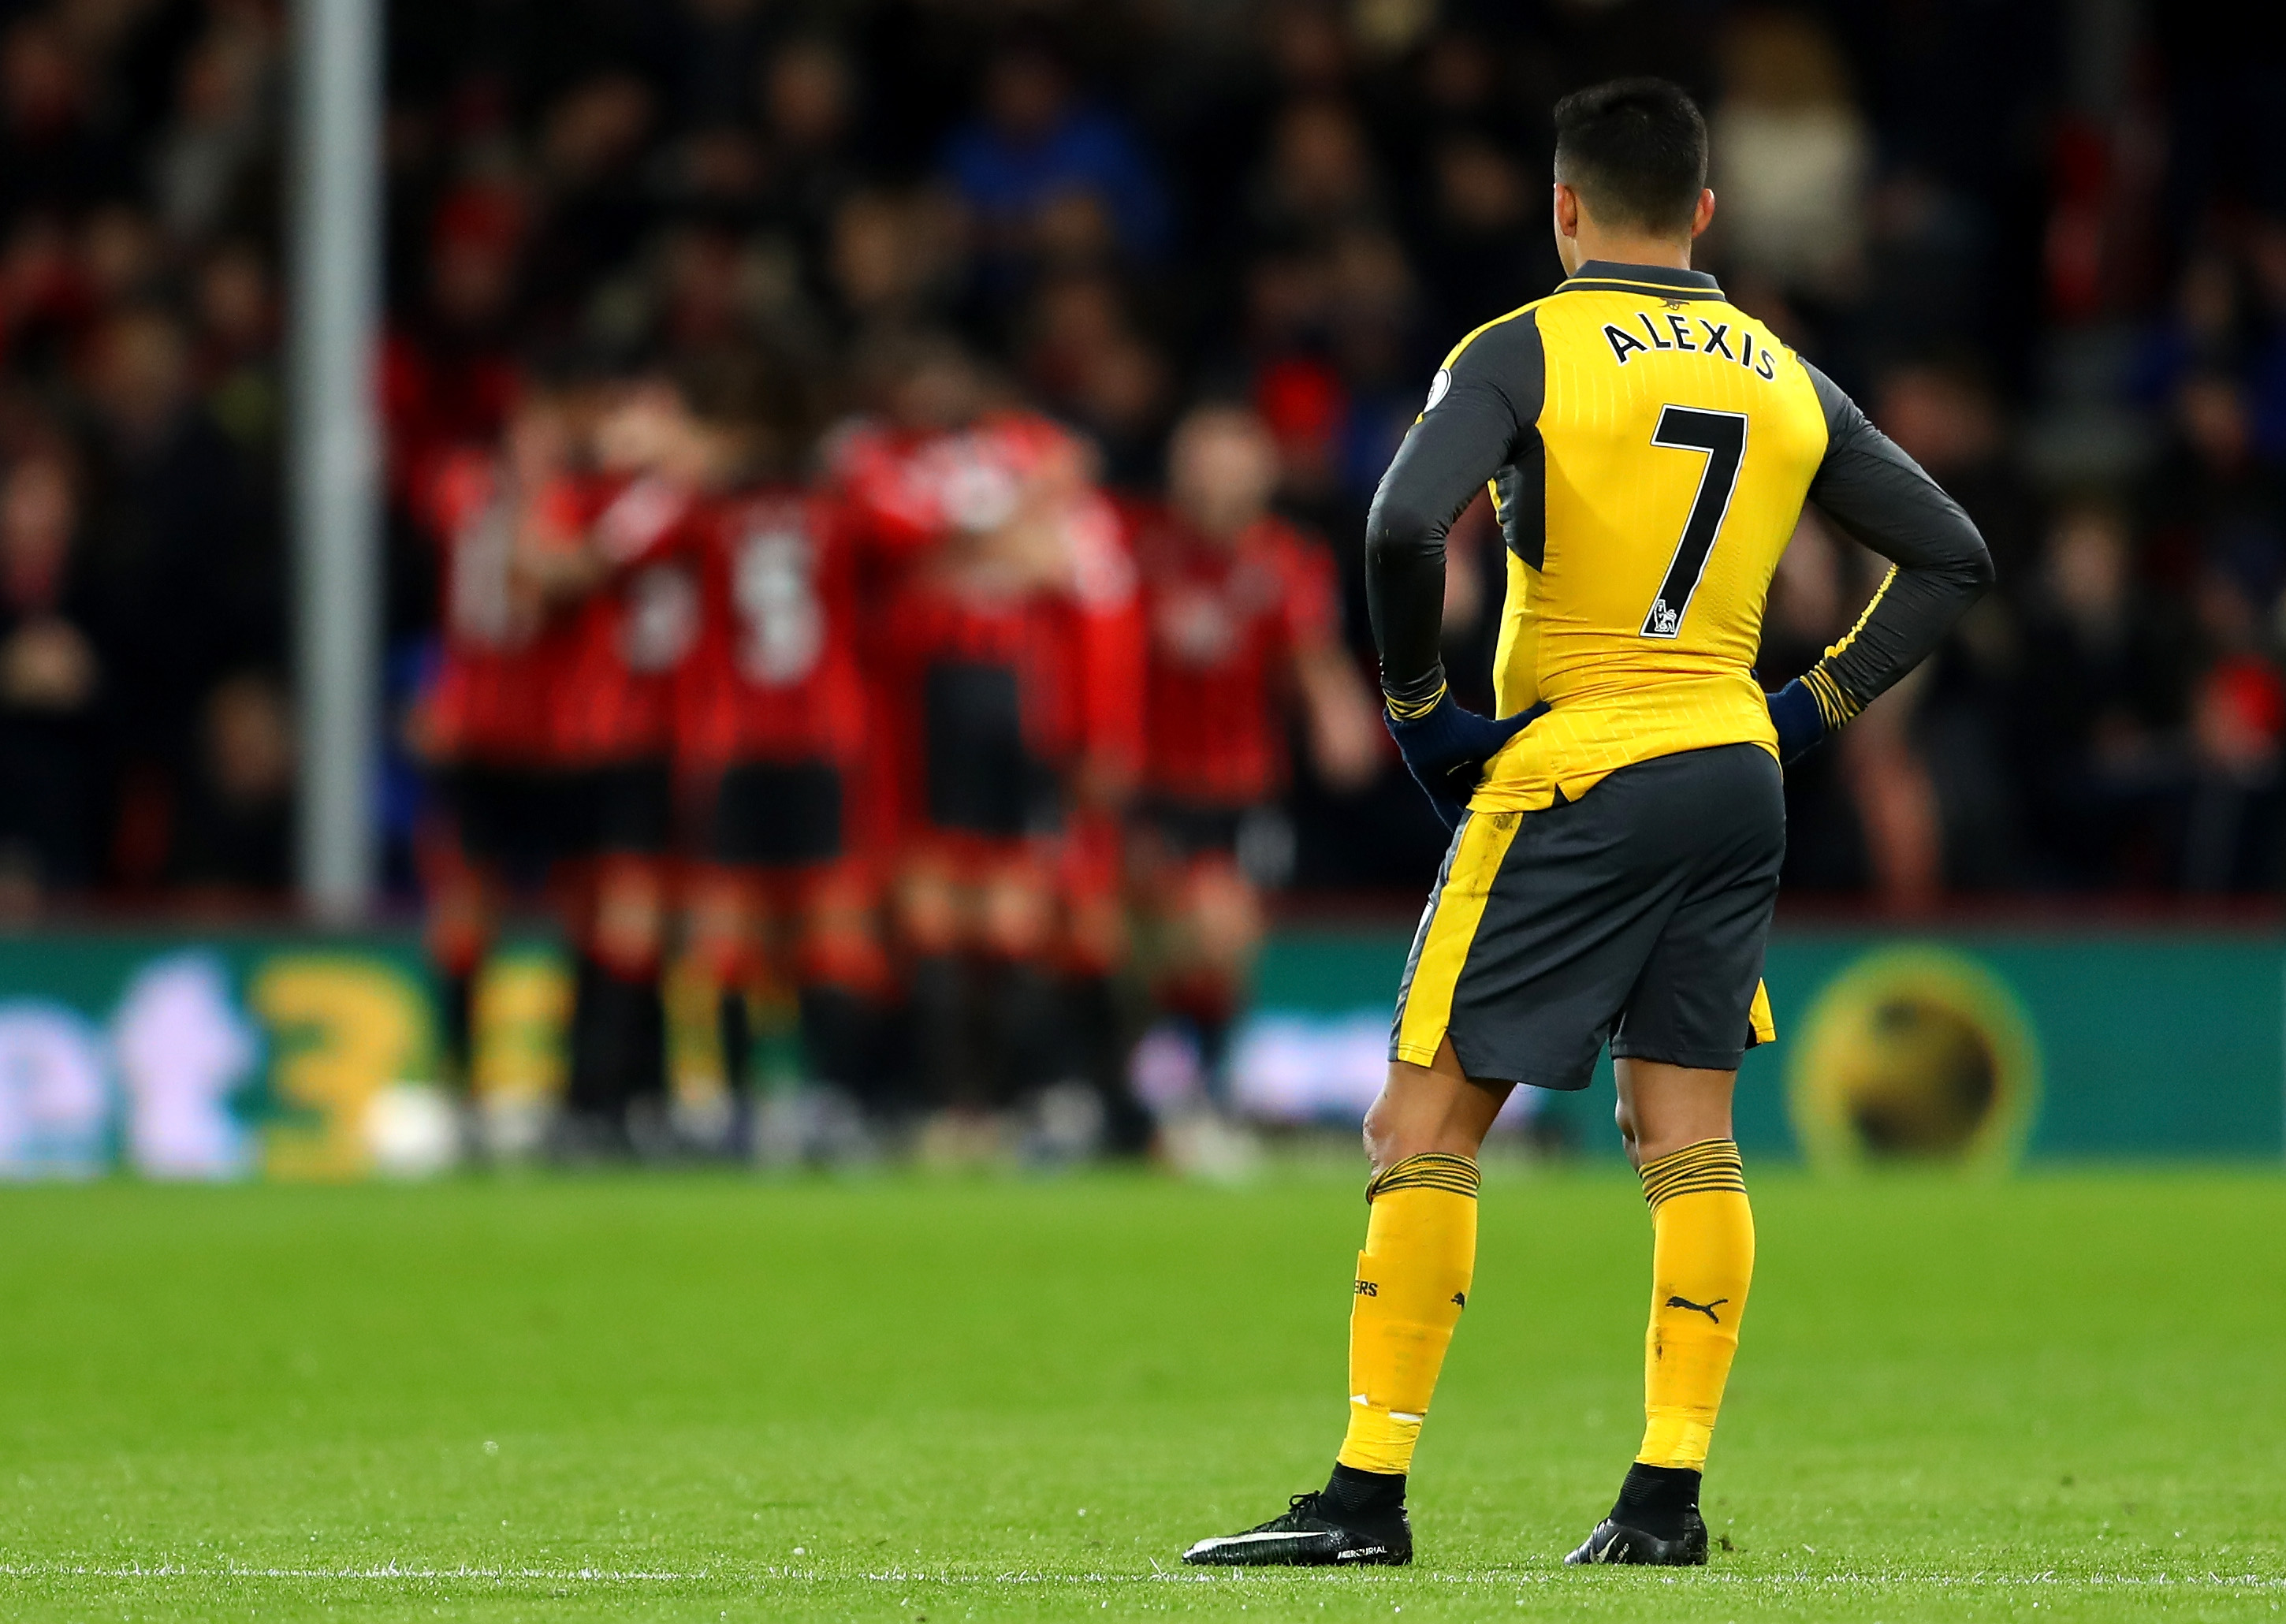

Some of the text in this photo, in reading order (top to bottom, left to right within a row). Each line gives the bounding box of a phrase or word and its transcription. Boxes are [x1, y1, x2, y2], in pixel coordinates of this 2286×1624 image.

[1603, 312, 1775, 380] ALEXIS
[1640, 404, 1748, 638] 7
[1354, 1279, 1378, 1297] ERS
[1337, 1545, 1387, 1559] MERCURIAL
